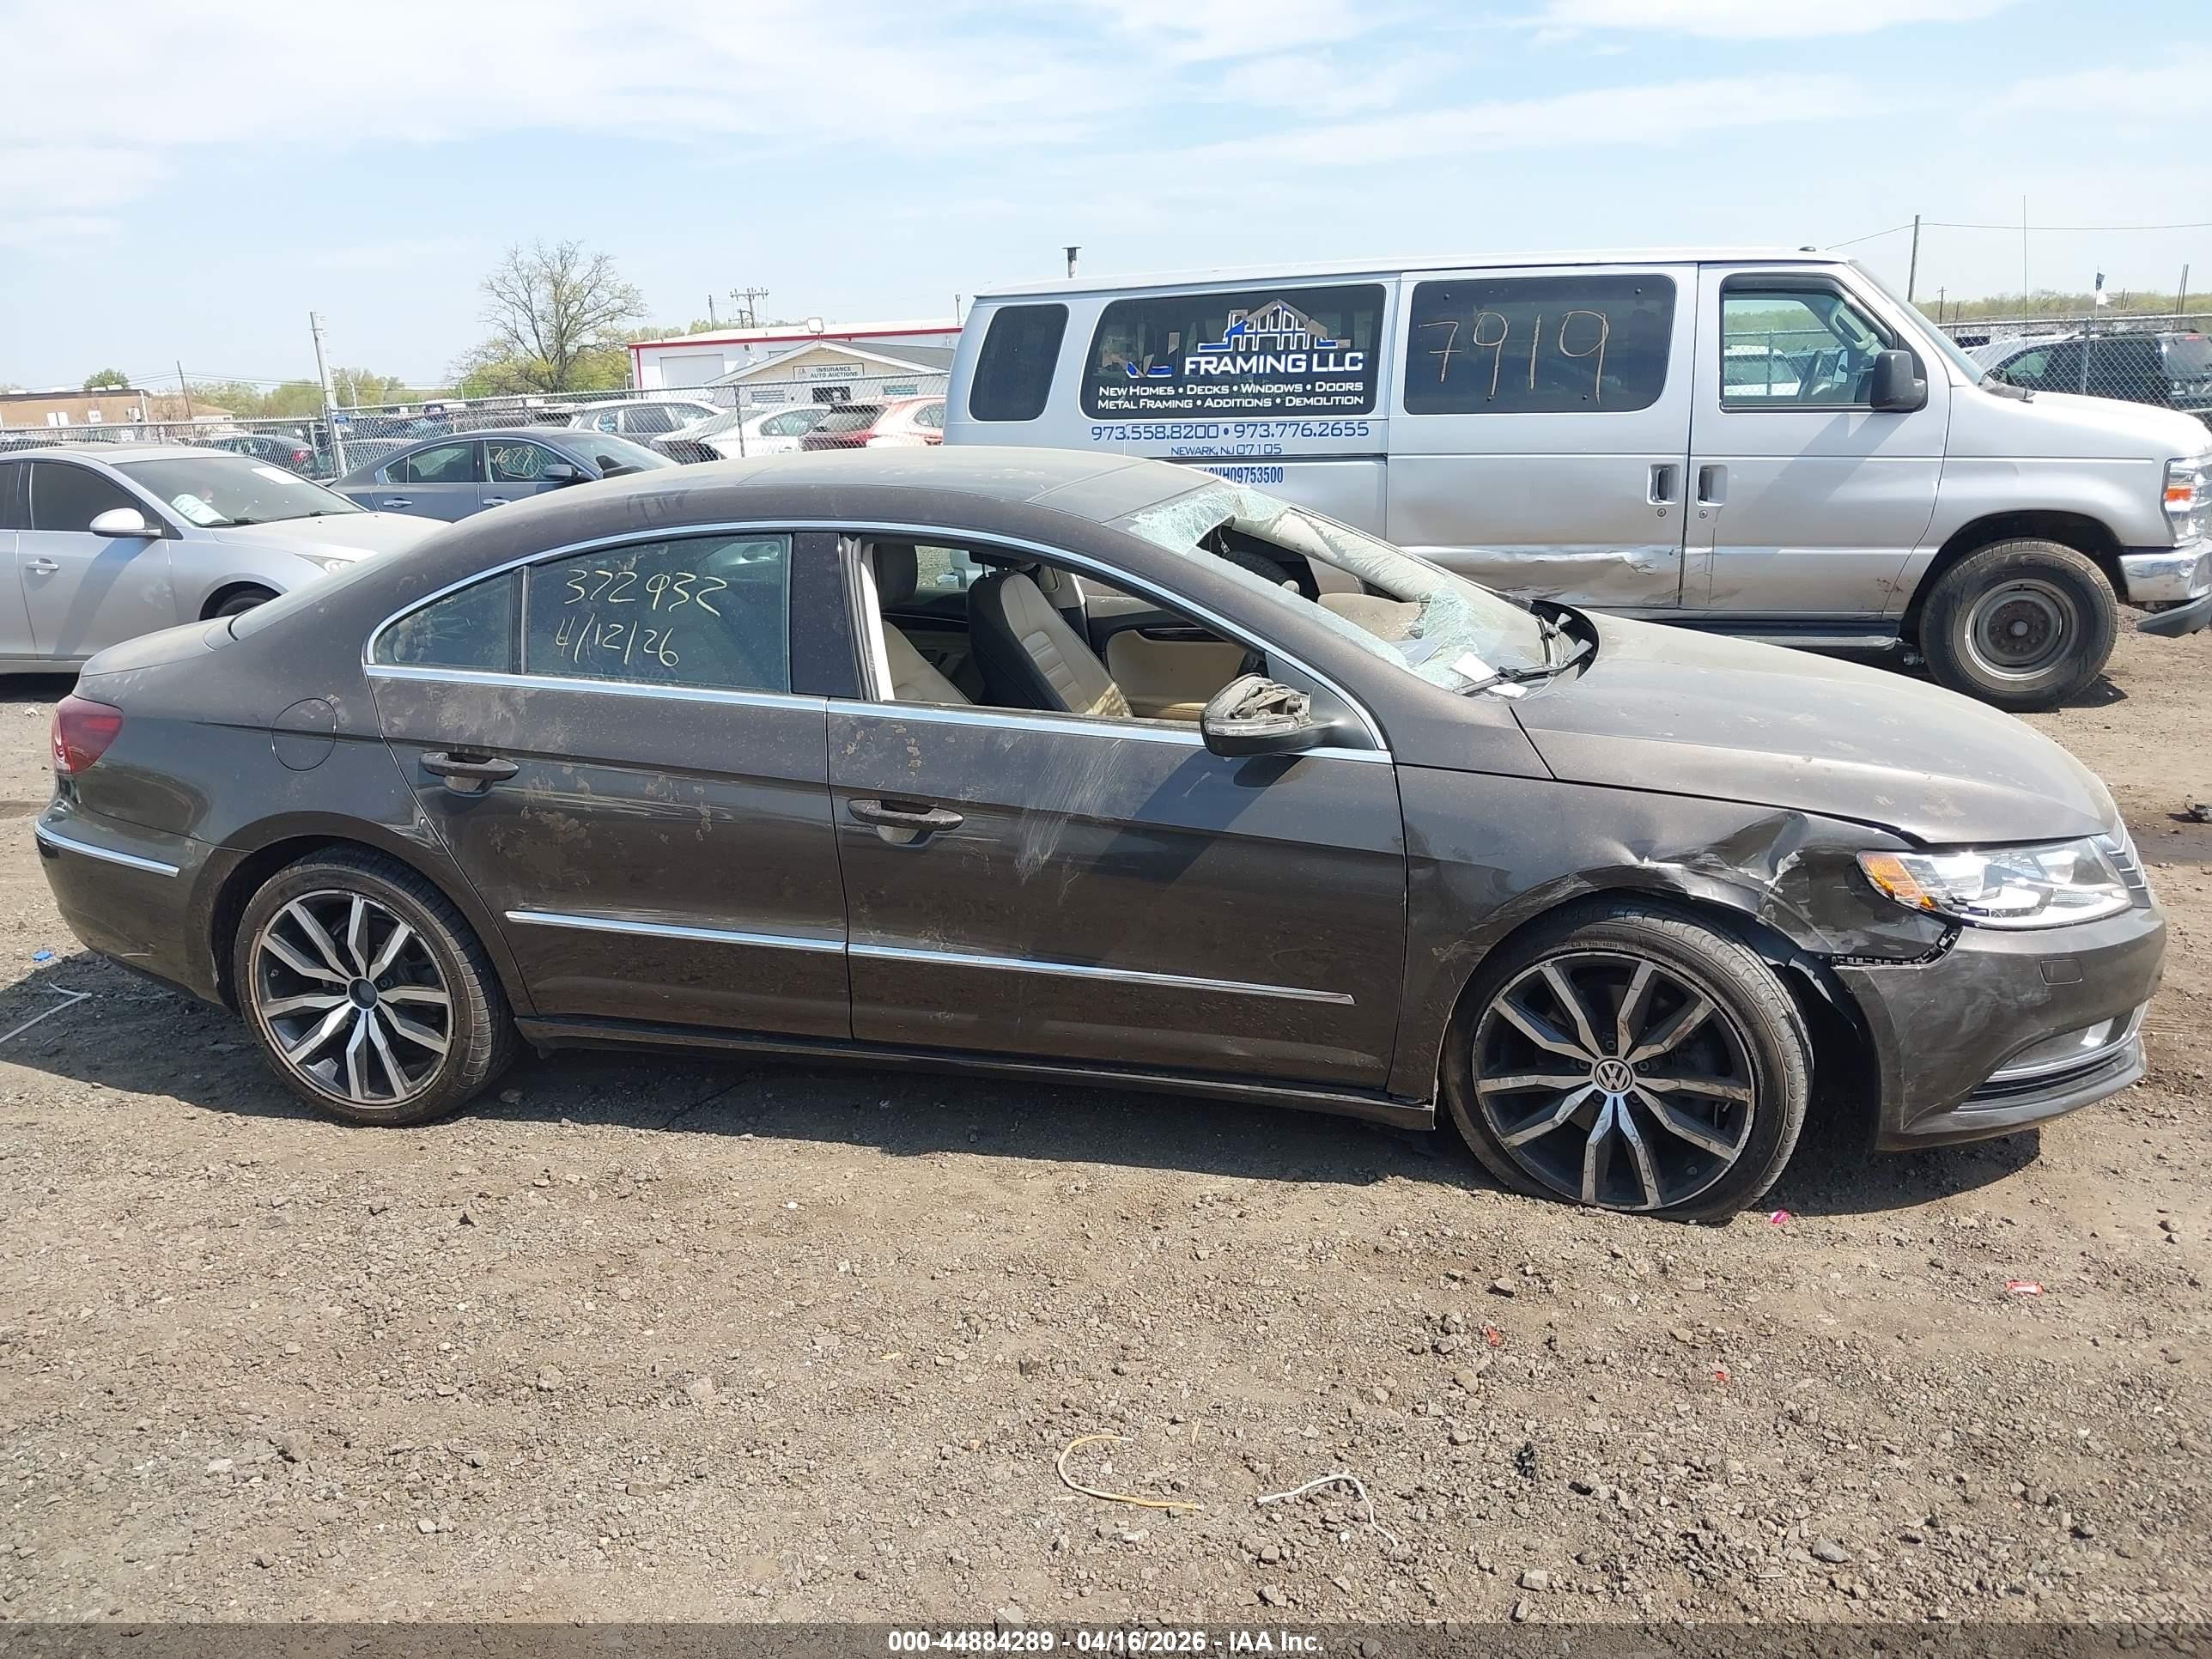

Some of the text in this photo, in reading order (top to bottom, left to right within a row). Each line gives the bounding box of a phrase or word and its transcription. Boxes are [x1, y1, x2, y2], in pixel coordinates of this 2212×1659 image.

[1184, 354, 1306, 375] FRAMING
[1312, 352, 1364, 372] LLC
[1418, 309, 1609, 405] 7919
[1099, 381, 1364, 396] NEW HOMES DECKS WINDOWS DOORS
[1097, 396, 1364, 410] METAL FRAMING ADDITIONS DEMOLITION
[1091, 422, 1369, 441] 973.558.8200 973.776.2655
[1220, 446, 1235, 455] NJ
[1237, 443, 1282, 455] 07105
[556, 612, 680, 667] 4/12/26
